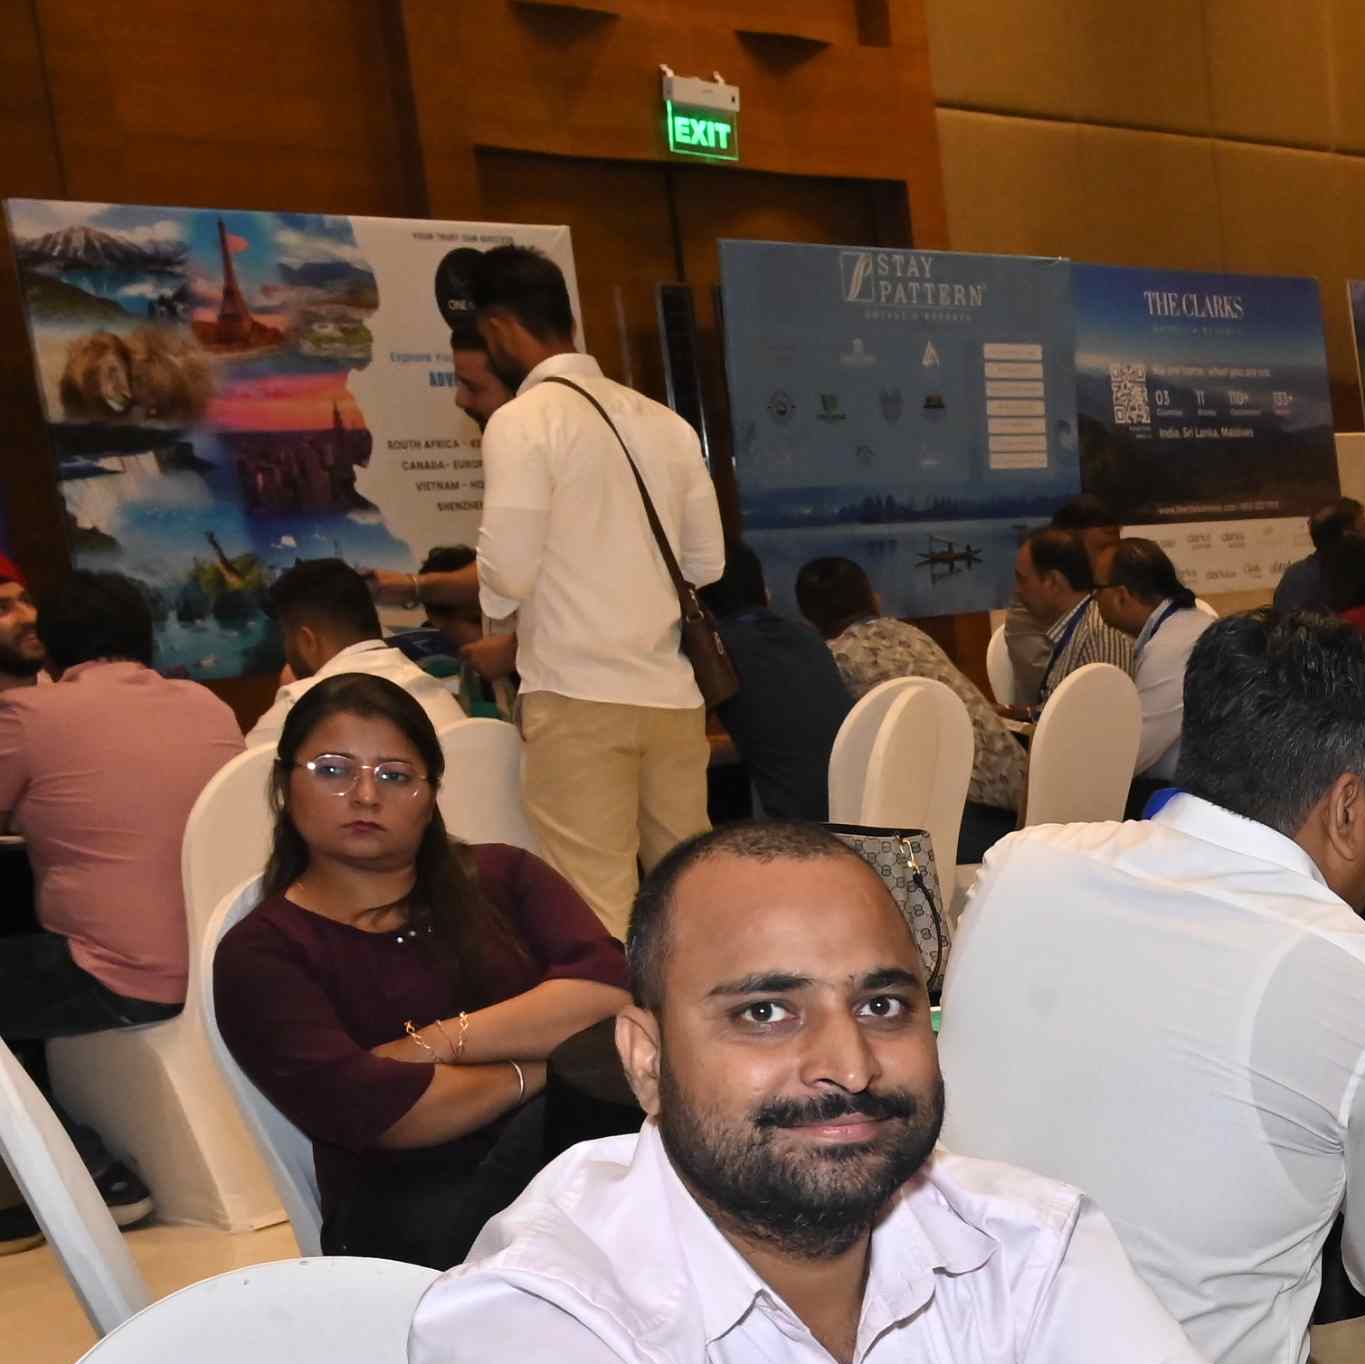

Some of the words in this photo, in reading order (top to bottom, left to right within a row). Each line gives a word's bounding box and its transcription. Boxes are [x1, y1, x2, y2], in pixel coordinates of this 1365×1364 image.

[674, 116, 731, 149] EXIT
[878, 254, 934, 278] STAY
[879, 280, 984, 306] PATTERN
[1144, 290, 1178, 317] THE
[1182, 292, 1244, 320] CLARKS
